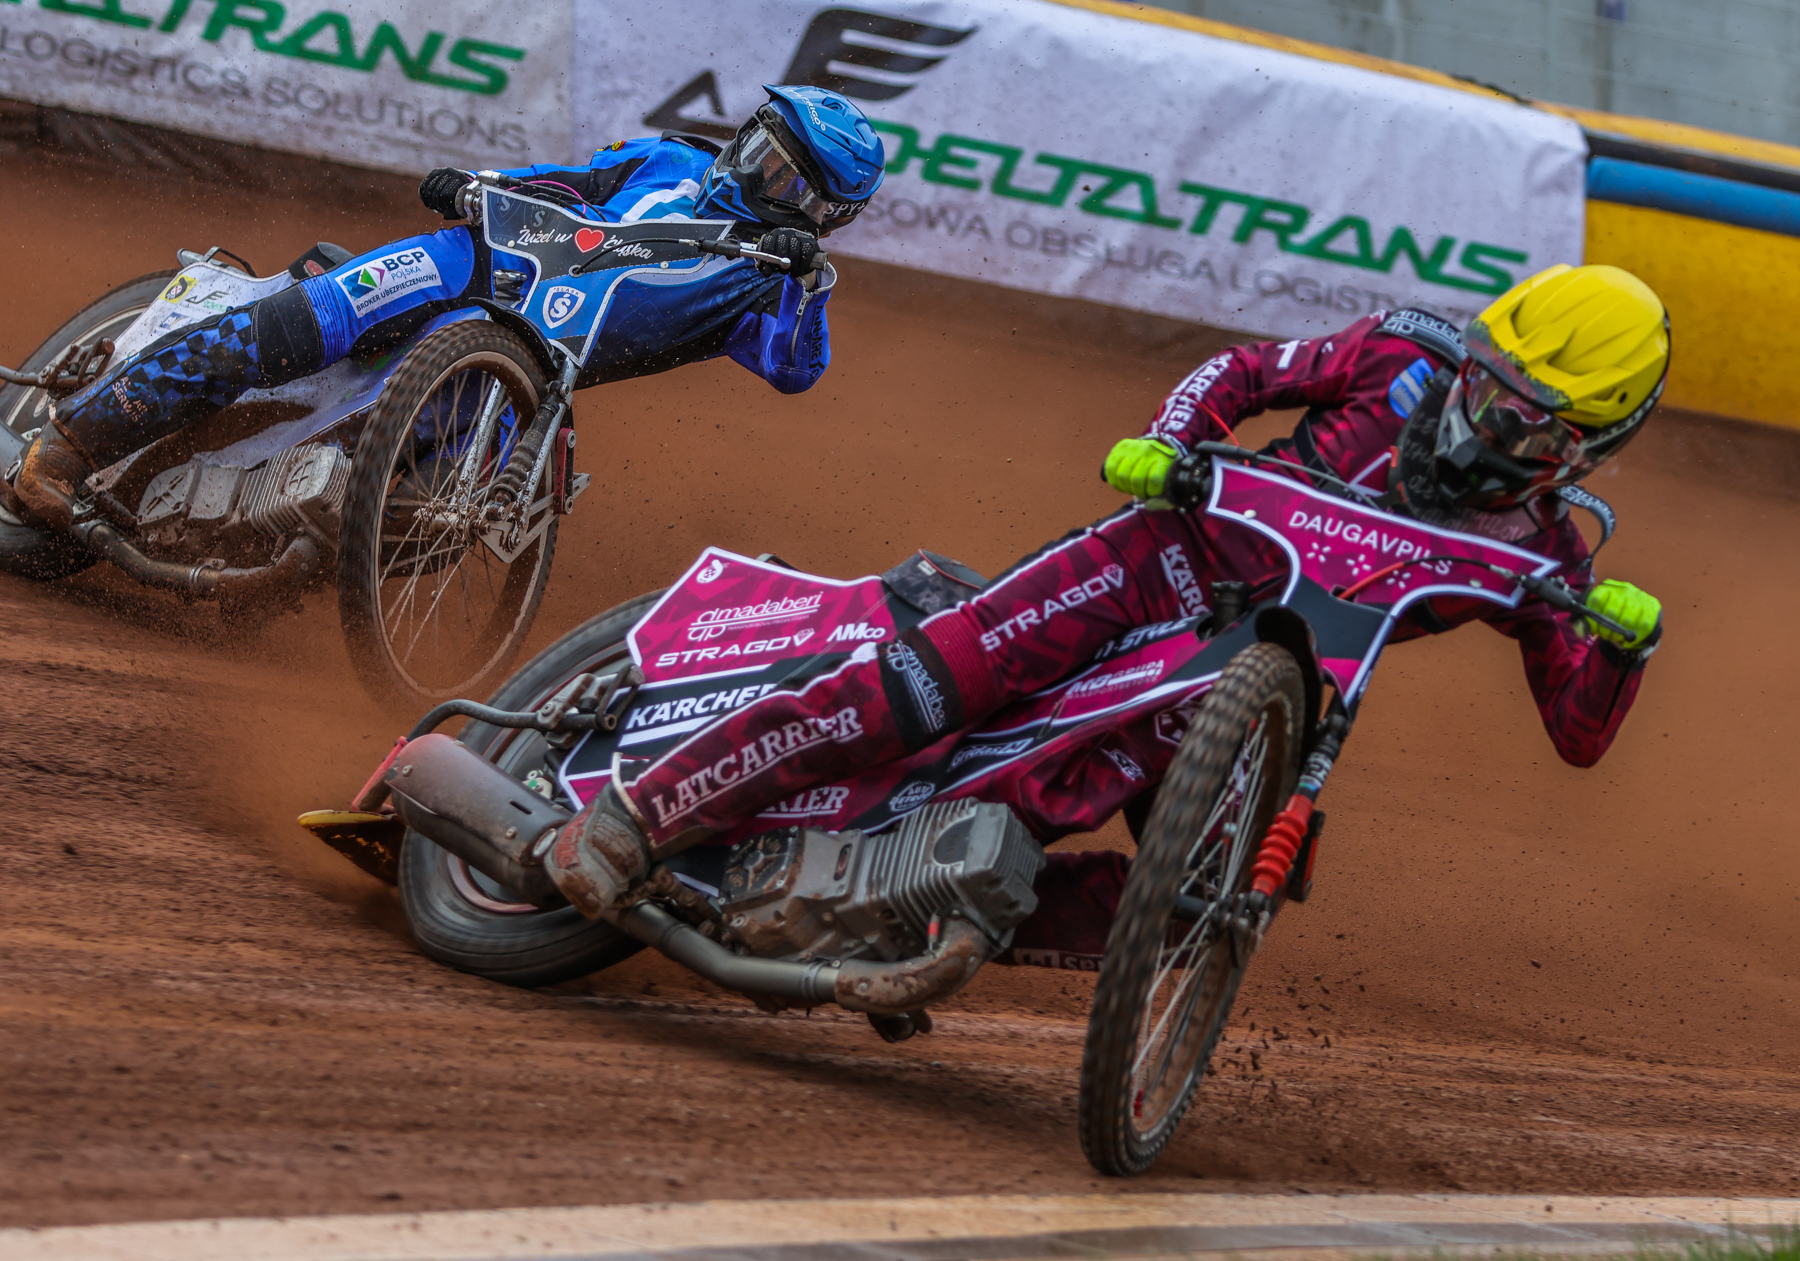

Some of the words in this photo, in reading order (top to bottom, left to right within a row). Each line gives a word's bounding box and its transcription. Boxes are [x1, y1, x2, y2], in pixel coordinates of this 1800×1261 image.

[262, 76, 528, 152] SOLUTIONS
[381, 251, 425, 272] BCP
[390, 265, 422, 281] POLSKA
[356, 293, 381, 312] BROKER
[380, 273, 438, 298] UBEZPIECZENIOWY
[1288, 510, 1453, 577] DAUGAVPILS
[651, 706, 863, 823] LATCARRIER
